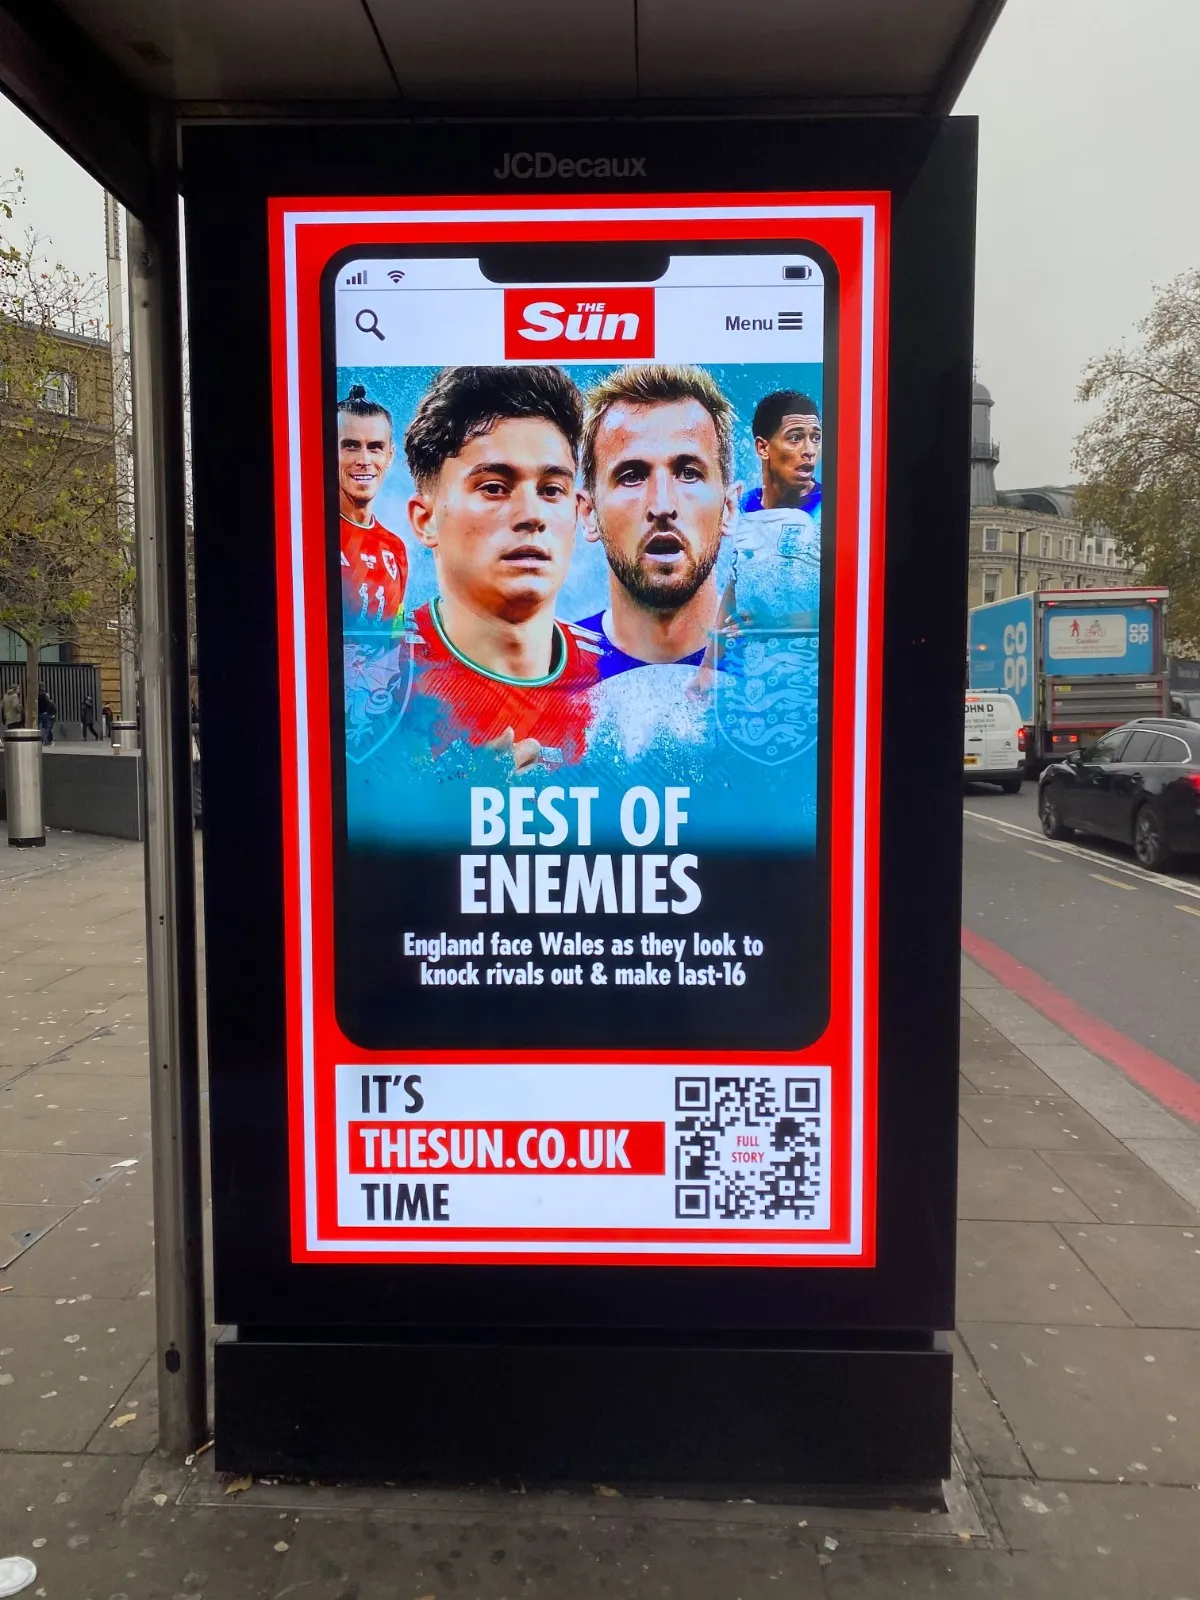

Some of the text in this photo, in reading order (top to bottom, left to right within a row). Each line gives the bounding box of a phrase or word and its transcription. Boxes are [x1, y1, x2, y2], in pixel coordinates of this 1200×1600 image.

[493, 151, 648, 179] JCDecaux
[517, 301, 641, 343] Sun
[576, 302, 605, 314] THE
[725, 315, 774, 332] Menu
[987, 704, 994, 713] D
[470, 786, 690, 847] BEST OF
[459, 853, 702, 915] ENEMIES
[403, 932, 764, 963] England face Wales as they look to
[420, 962, 747, 986] knock rivals out & make last-16
[360, 1128, 632, 1170] THESUN.CO.UK
[736, 1136, 760, 1147] FULL
[731, 1152, 765, 1164] STORY
[360, 1183, 450, 1222] TIME
